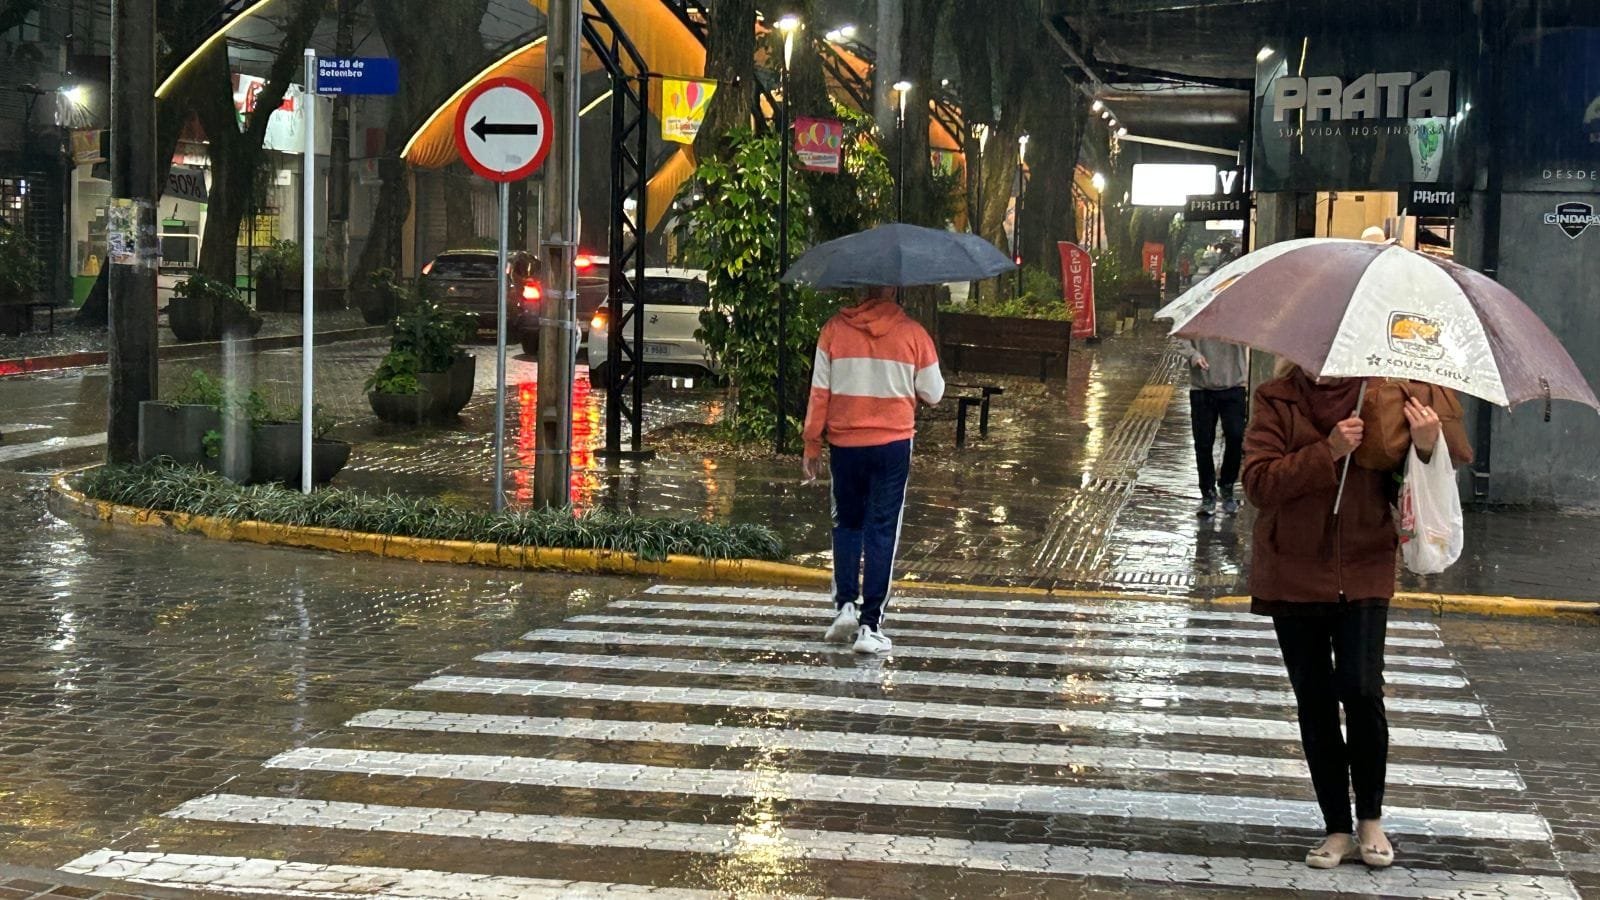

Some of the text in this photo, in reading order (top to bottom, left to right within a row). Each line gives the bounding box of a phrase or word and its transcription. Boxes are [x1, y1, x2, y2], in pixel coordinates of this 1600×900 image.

[319, 59, 337, 68] Rua
[352, 60, 365, 69] de
[319, 68, 363, 78] Setembro
[1273, 70, 1451, 122] PRATA
[1279, 127, 1302, 138] SUA
[1310, 127, 1342, 136] VIDA
[1351, 126, 1378, 136] NOS
[1543, 169, 1597, 181] DESDE
[168, 173, 202, 198] 50%
[1412, 190, 1455, 205] PRATA
